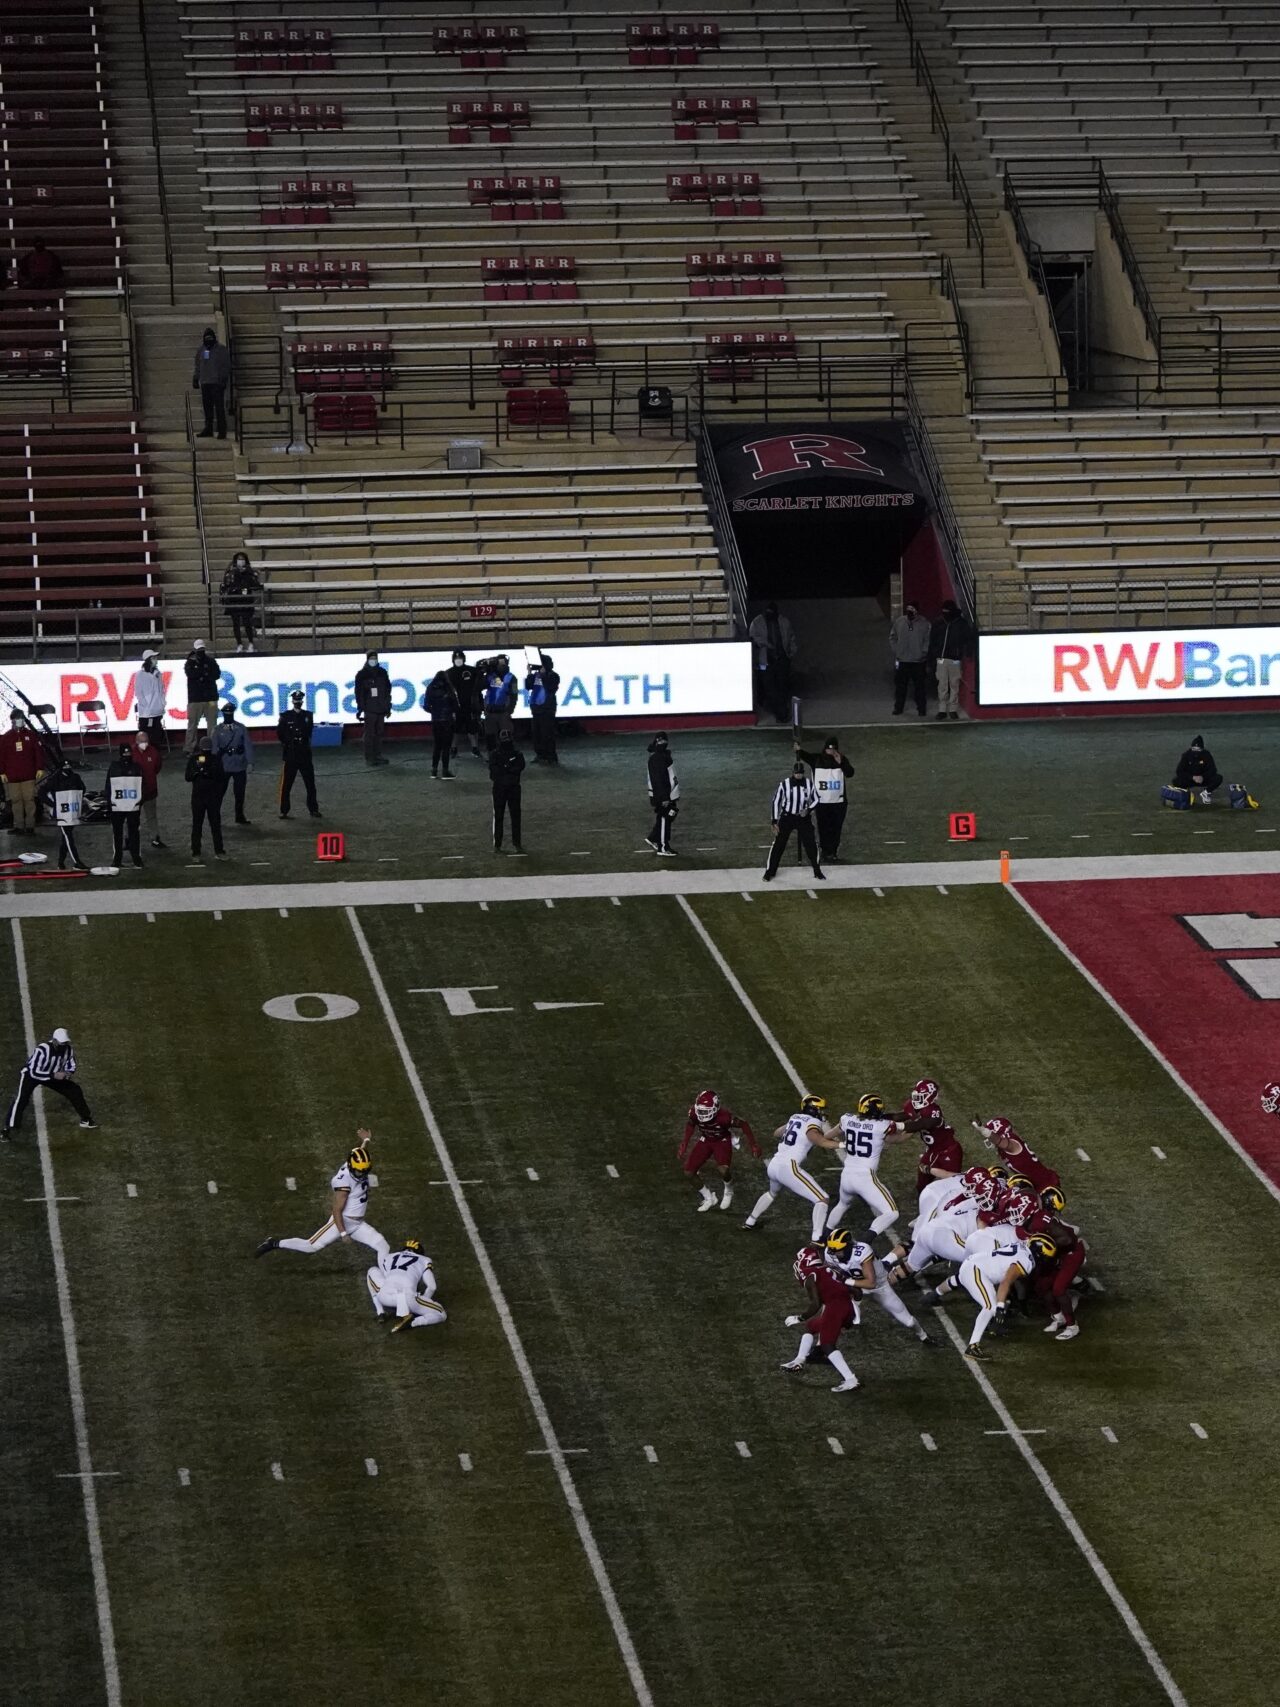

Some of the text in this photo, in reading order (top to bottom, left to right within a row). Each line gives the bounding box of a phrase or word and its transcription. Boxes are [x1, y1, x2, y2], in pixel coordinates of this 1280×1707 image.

[239, 31, 325, 41] R R R R
[438, 27, 519, 39] R R R R
[631, 25, 713, 35] R R R R
[249, 105, 336, 116] R R R R
[452, 102, 523, 113] R R R R
[676, 99, 752, 110] R R R R
[473, 178, 555, 189] R R R R
[672, 174, 753, 186] R R R R
[287, 182, 347, 192] R R R
[486, 258, 569, 269] R R R R
[691, 253, 776, 265] R R R R
[271, 261, 361, 273] R R R R
[742, 433, 885, 480] R
[733, 493, 915, 512] SCARLET KNIGHTS
[474, 606, 493, 616] 129
[955, 815, 971, 835] G
[322, 836, 340, 856] 10
[846, 1128, 873, 1158] 85
[390, 1254, 419, 1271] 17
